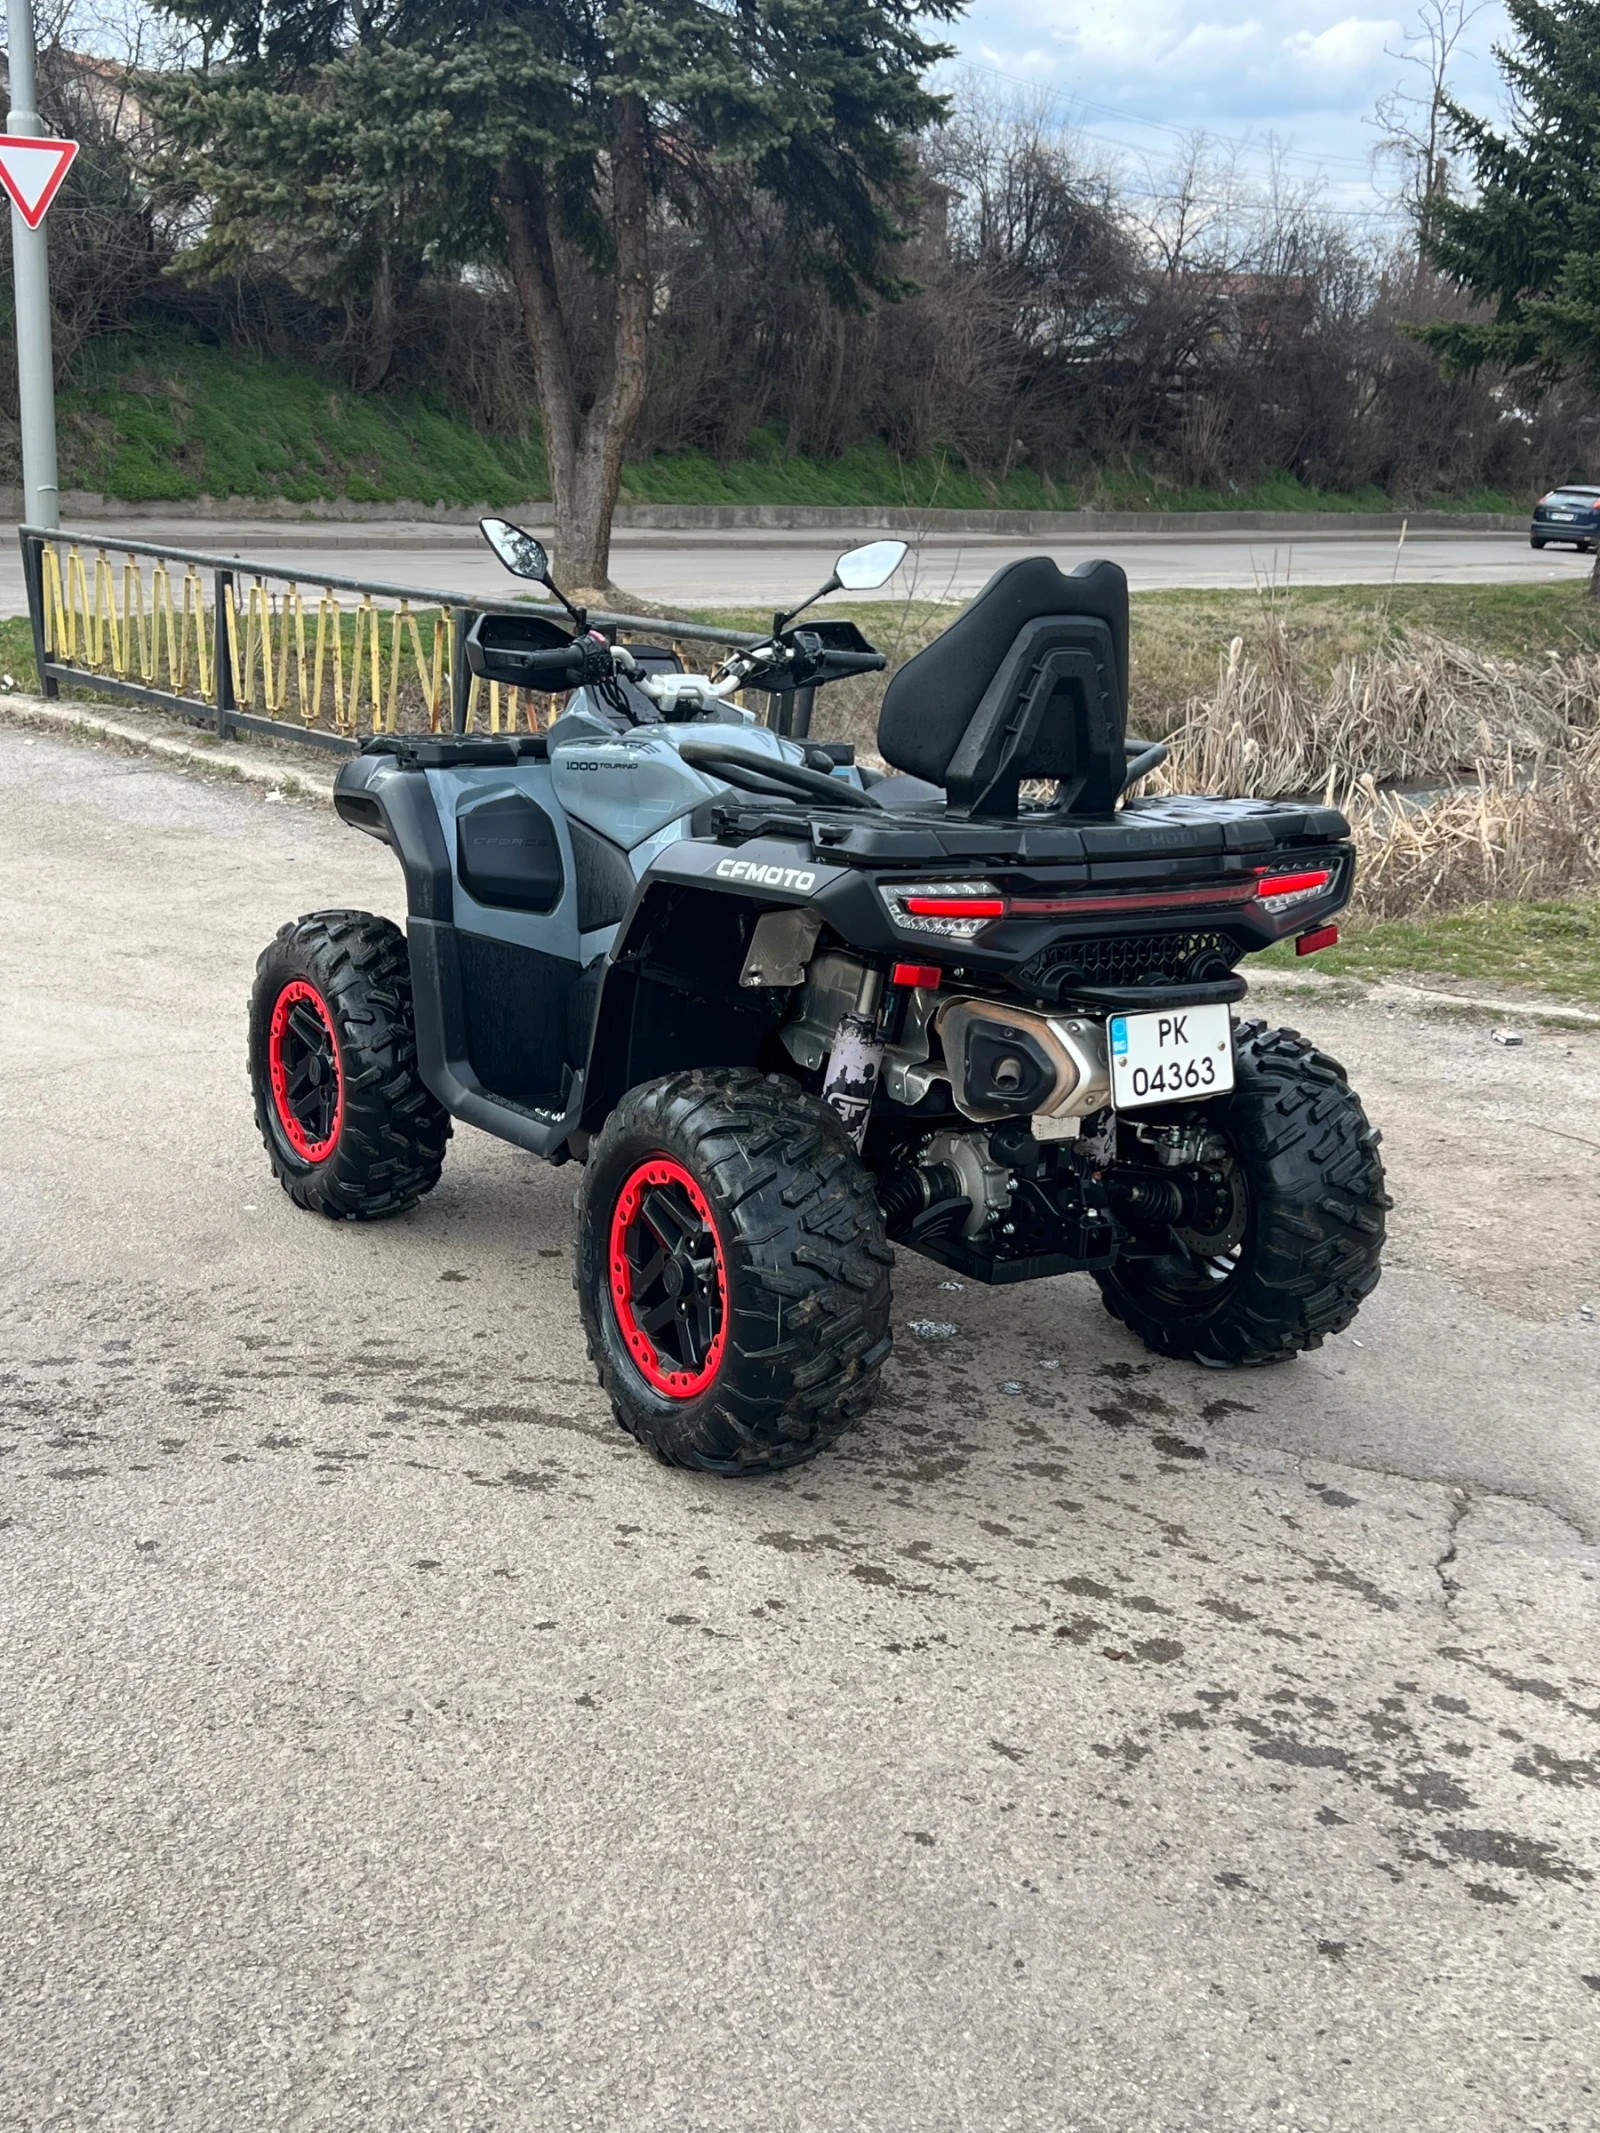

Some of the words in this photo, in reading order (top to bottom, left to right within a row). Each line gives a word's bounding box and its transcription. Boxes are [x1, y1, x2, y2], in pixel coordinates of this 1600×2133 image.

[565, 760, 598, 772] 1000
[598, 761, 639, 770] TOURING
[715, 858, 816, 891] CFMOTO
[1112, 1040, 1127, 1052] BG
[1158, 1015, 1189, 1048] PK
[1132, 1056, 1216, 1097] 04363
